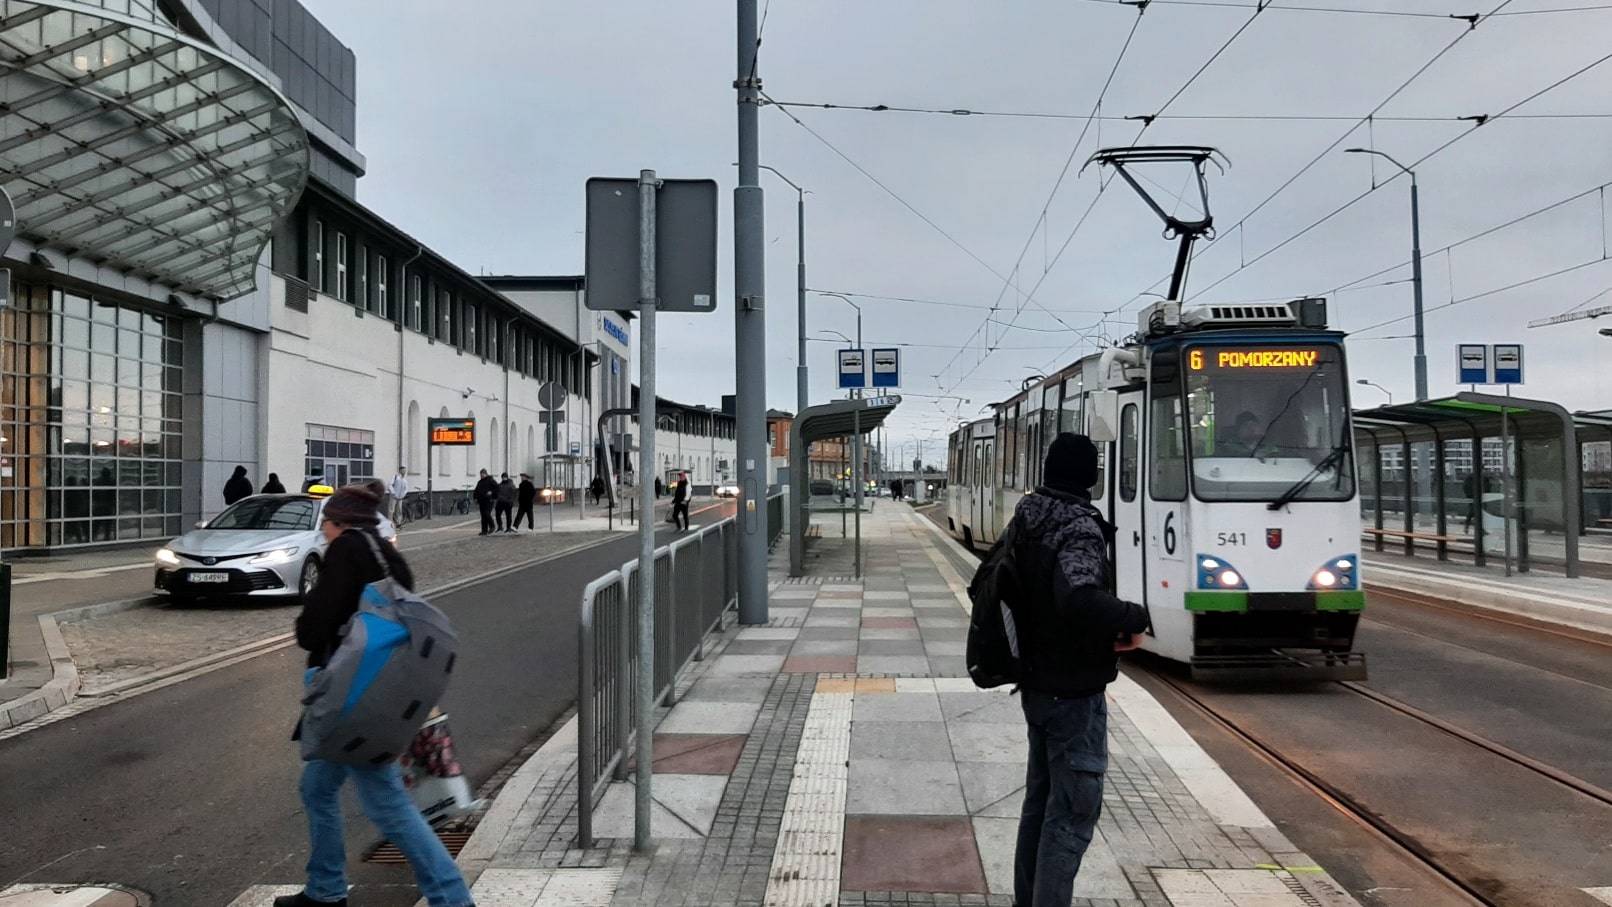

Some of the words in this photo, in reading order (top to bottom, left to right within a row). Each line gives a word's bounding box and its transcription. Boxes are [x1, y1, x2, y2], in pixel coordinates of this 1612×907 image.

[1190, 350, 1203, 370] 6
[1218, 351, 1317, 367] POMORZANY
[1163, 511, 1176, 555] 6
[1217, 532, 1247, 547] 541
